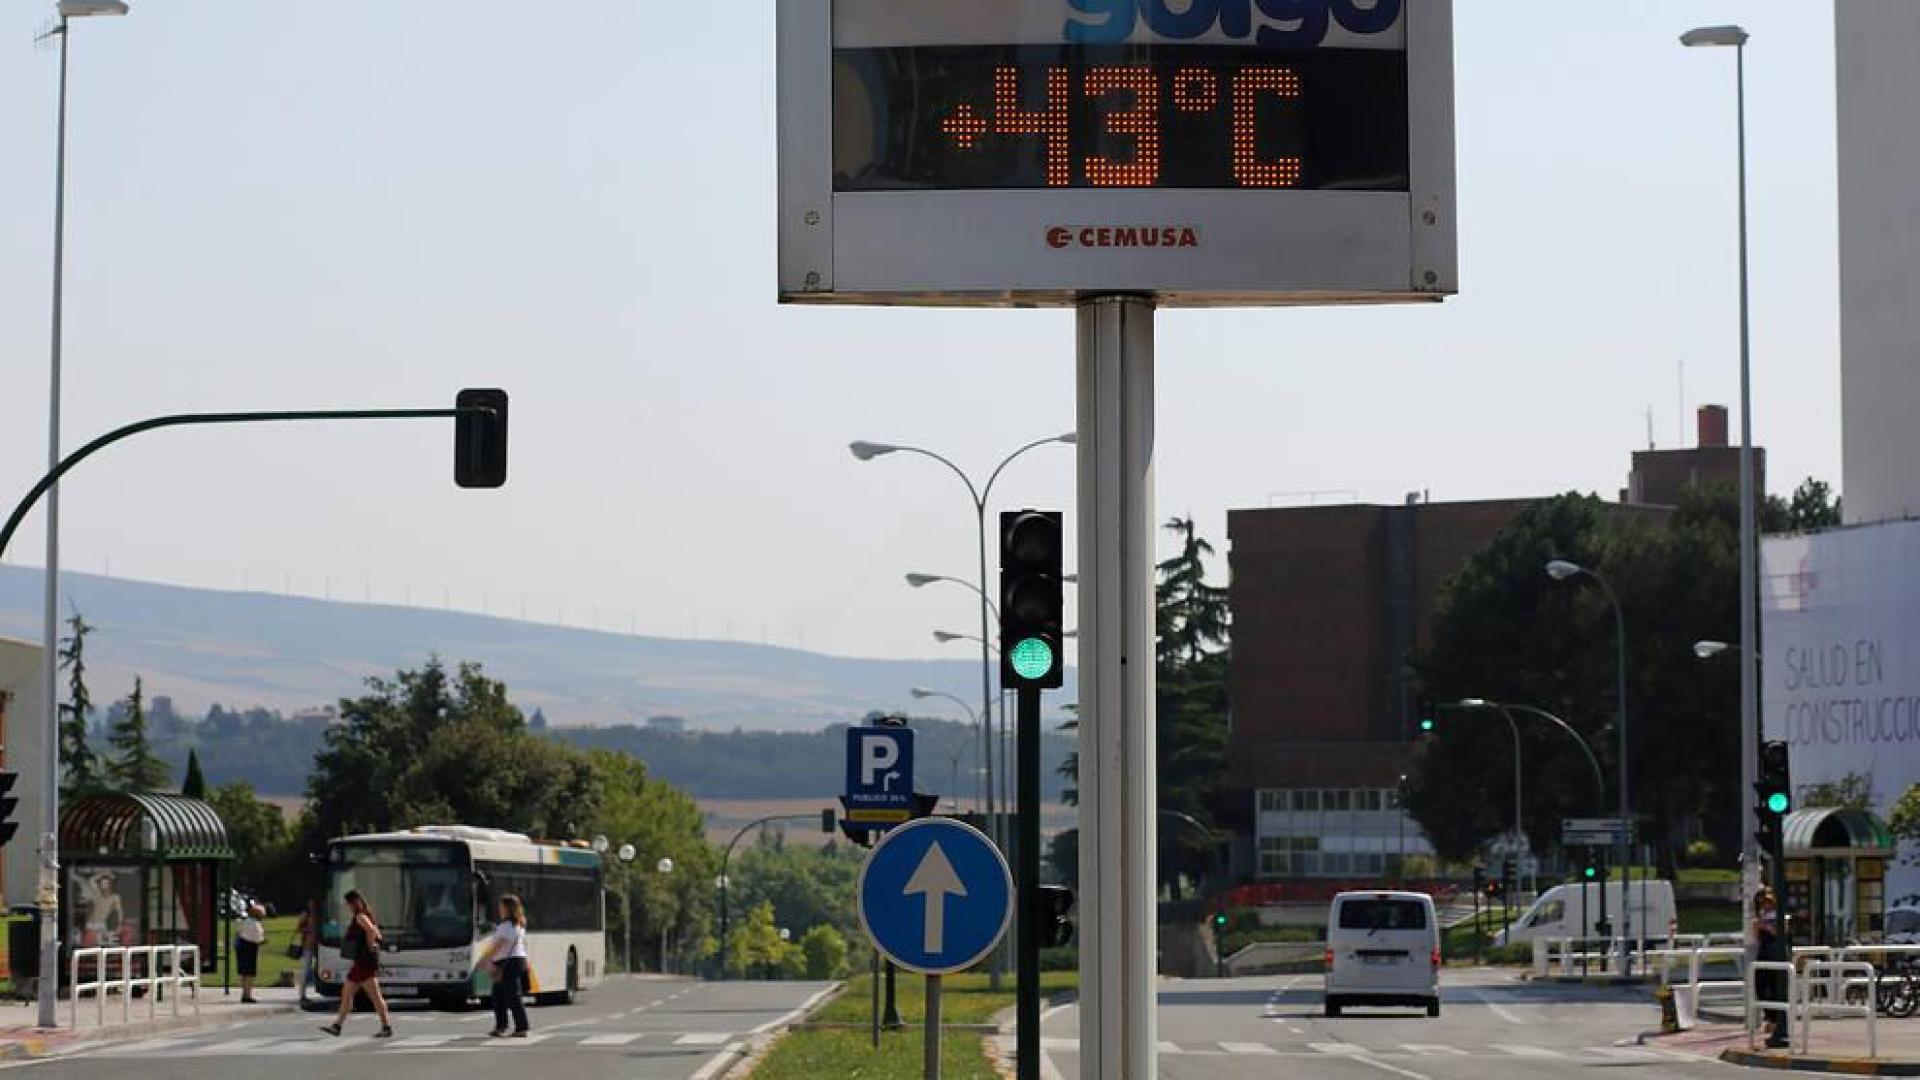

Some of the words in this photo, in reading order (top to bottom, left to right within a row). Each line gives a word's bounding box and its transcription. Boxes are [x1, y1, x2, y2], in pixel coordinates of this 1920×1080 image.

[1079, 227, 1198, 248] CEMUSA
[1784, 644, 1848, 691] SALUD
[1855, 639, 1883, 686] EN
[860, 734, 899, 785] P
